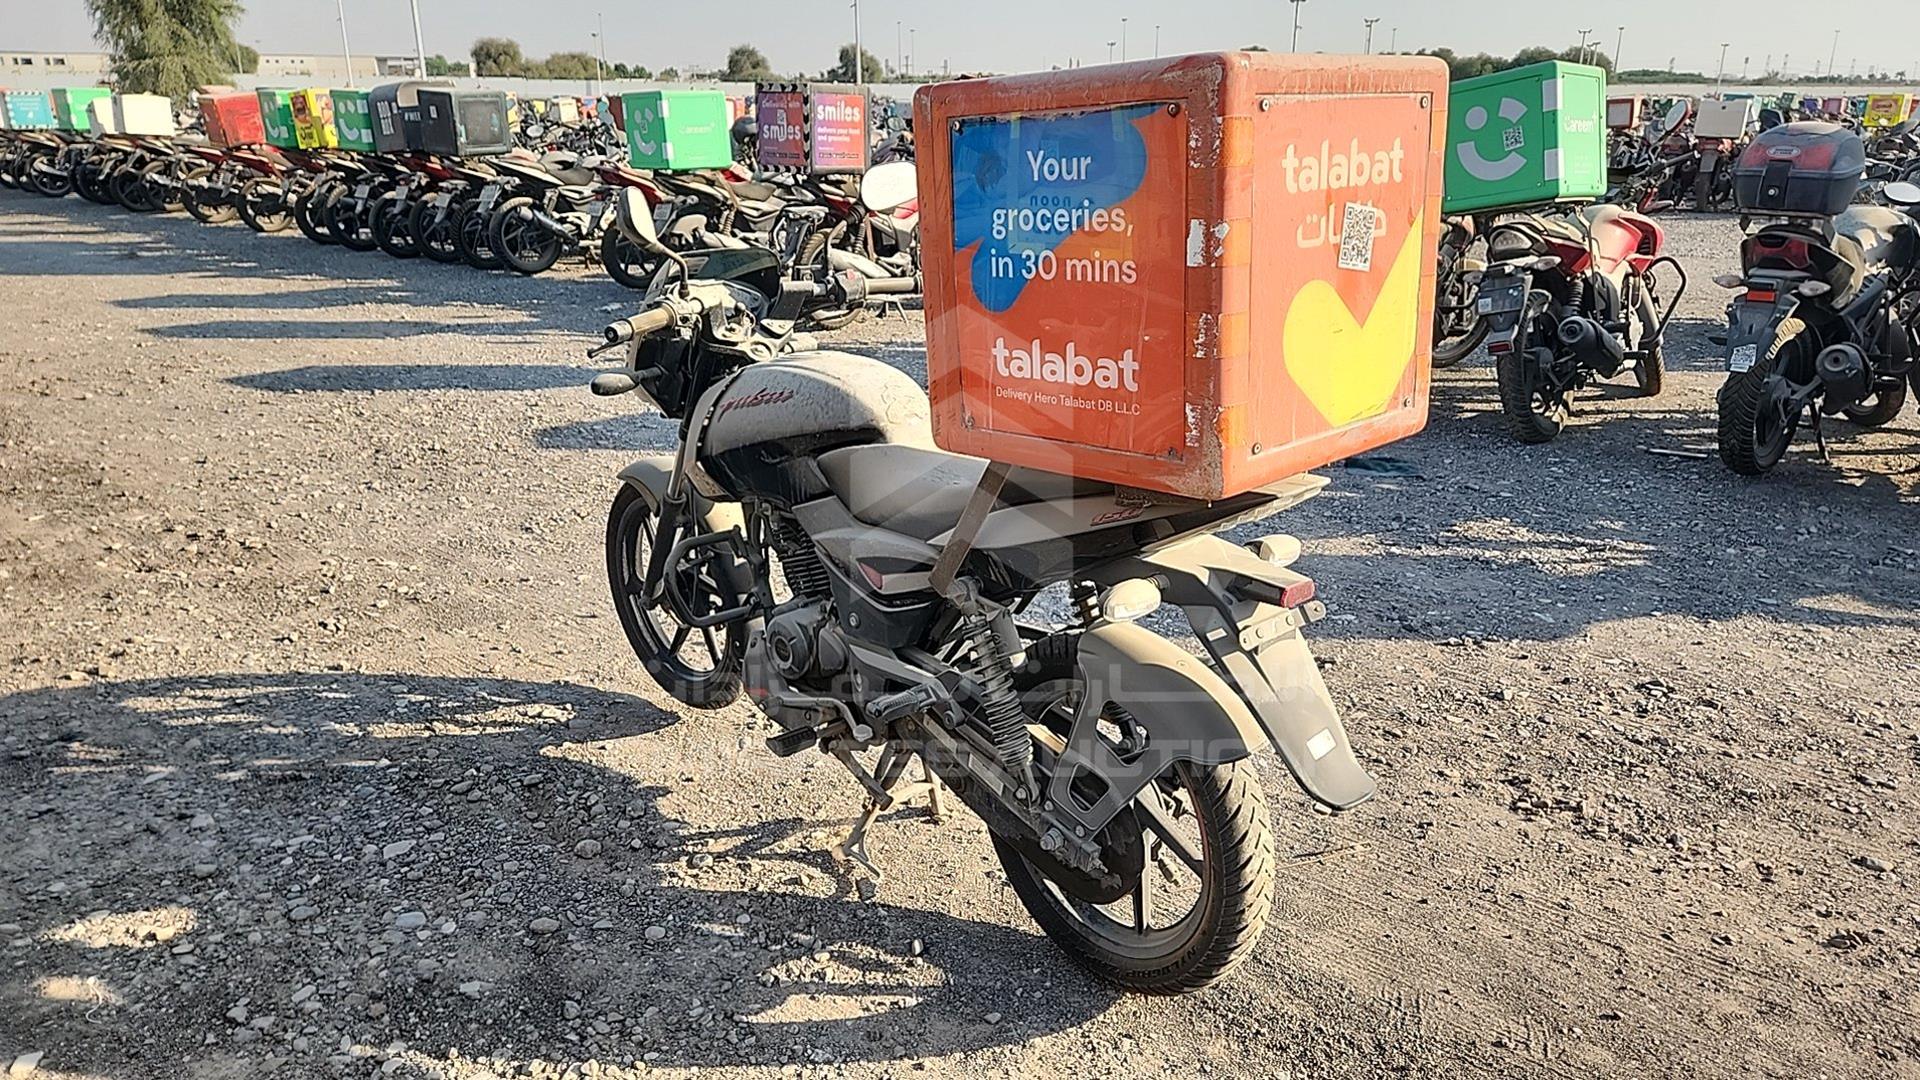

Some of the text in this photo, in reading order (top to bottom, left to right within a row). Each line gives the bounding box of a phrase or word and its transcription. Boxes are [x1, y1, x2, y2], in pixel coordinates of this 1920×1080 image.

[816, 101, 860, 122] smiles
[1026, 150, 1092, 182] Your
[1282, 135, 1404, 195] talabat
[992, 199, 1134, 240] groceries,
[990, 248, 1138, 284] in 30 mins
[992, 336, 1140, 393] talabat
[995, 385, 1033, 405] Delivery
[1034, 391, 1057, 405] Hero
[1058, 394, 1096, 411] Talabat
[1097, 399, 1113, 412] DB
